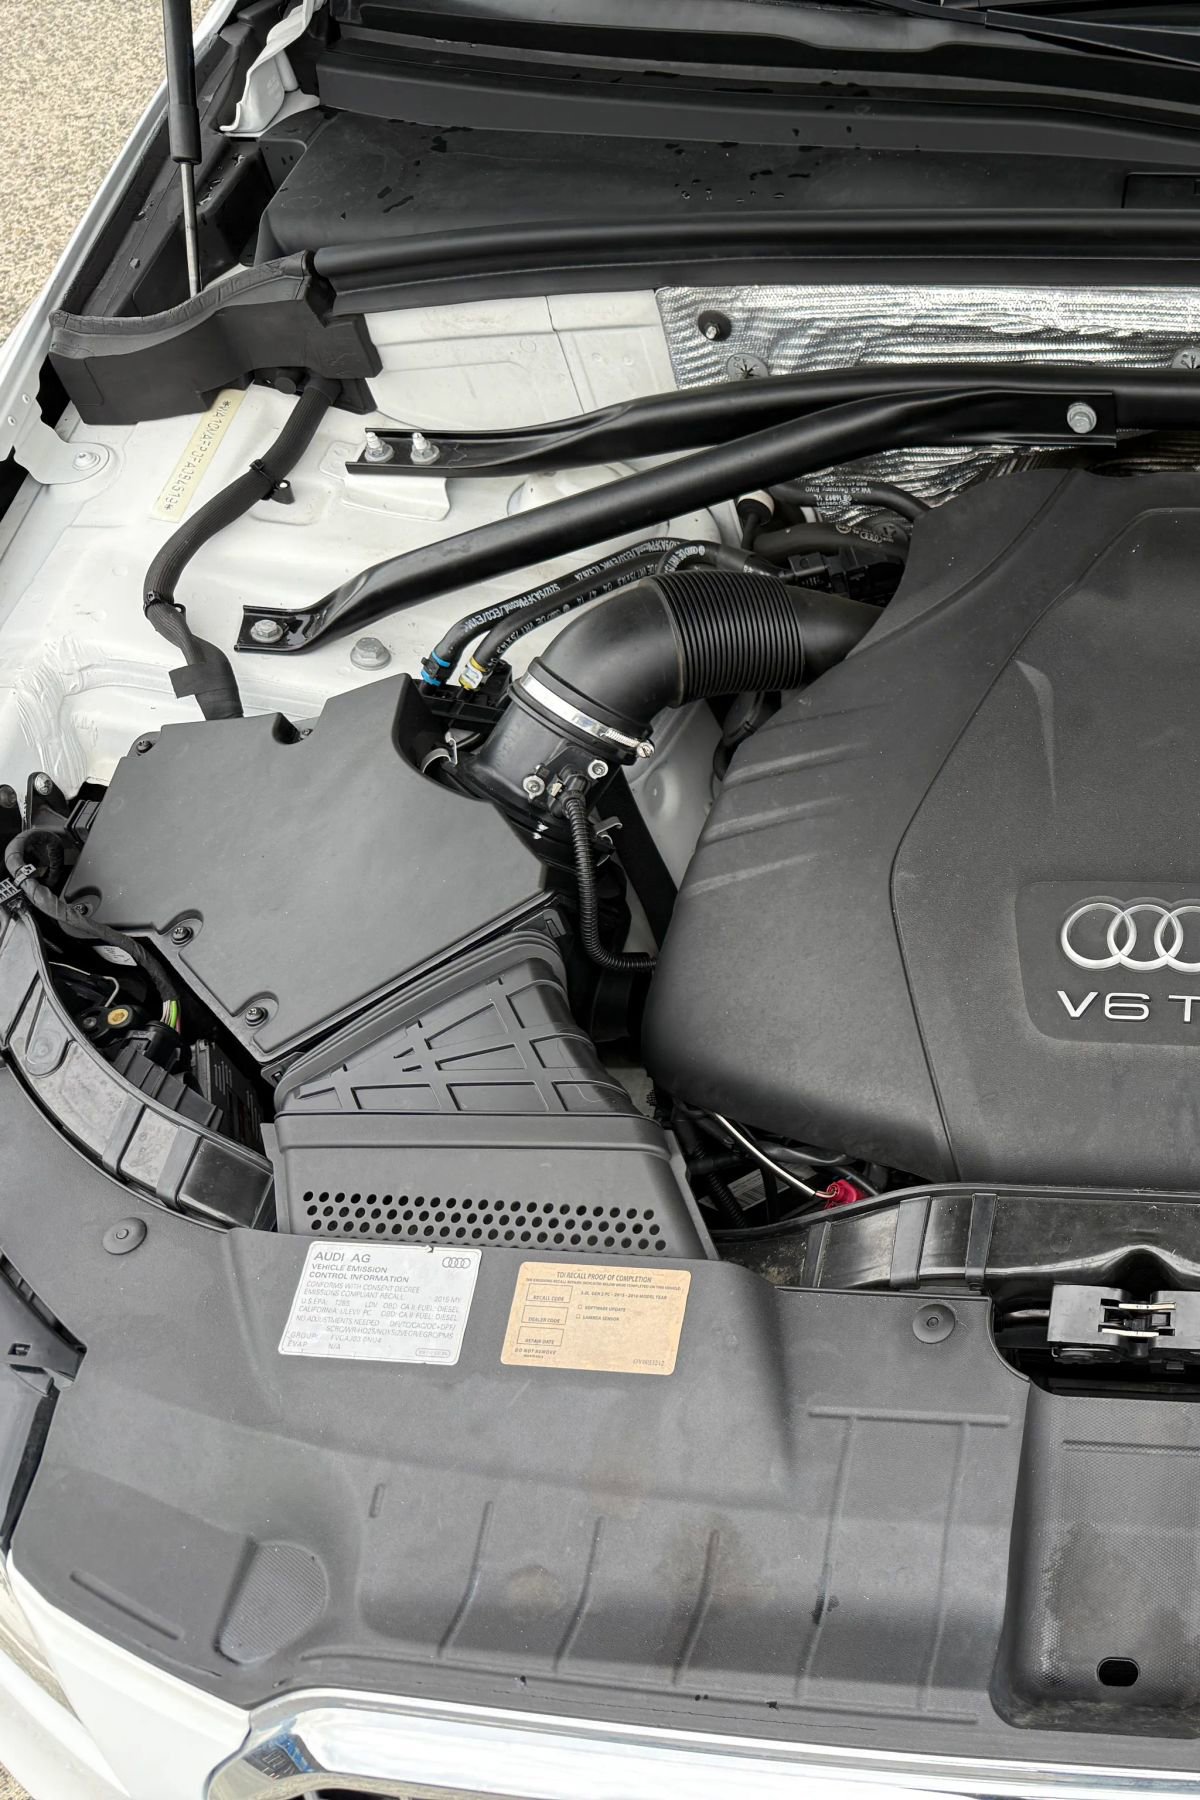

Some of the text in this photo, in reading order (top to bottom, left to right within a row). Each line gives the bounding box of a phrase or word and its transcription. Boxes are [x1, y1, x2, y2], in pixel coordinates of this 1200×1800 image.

[1057, 990, 1151, 1021] V6
[313, 1251, 371, 1263] AUDI AG
[346, 1265, 388, 1273] EMISSION
[308, 1271, 409, 1283] CONTROL INFORMATION
[615, 1274, 652, 1283] COMPLETION
